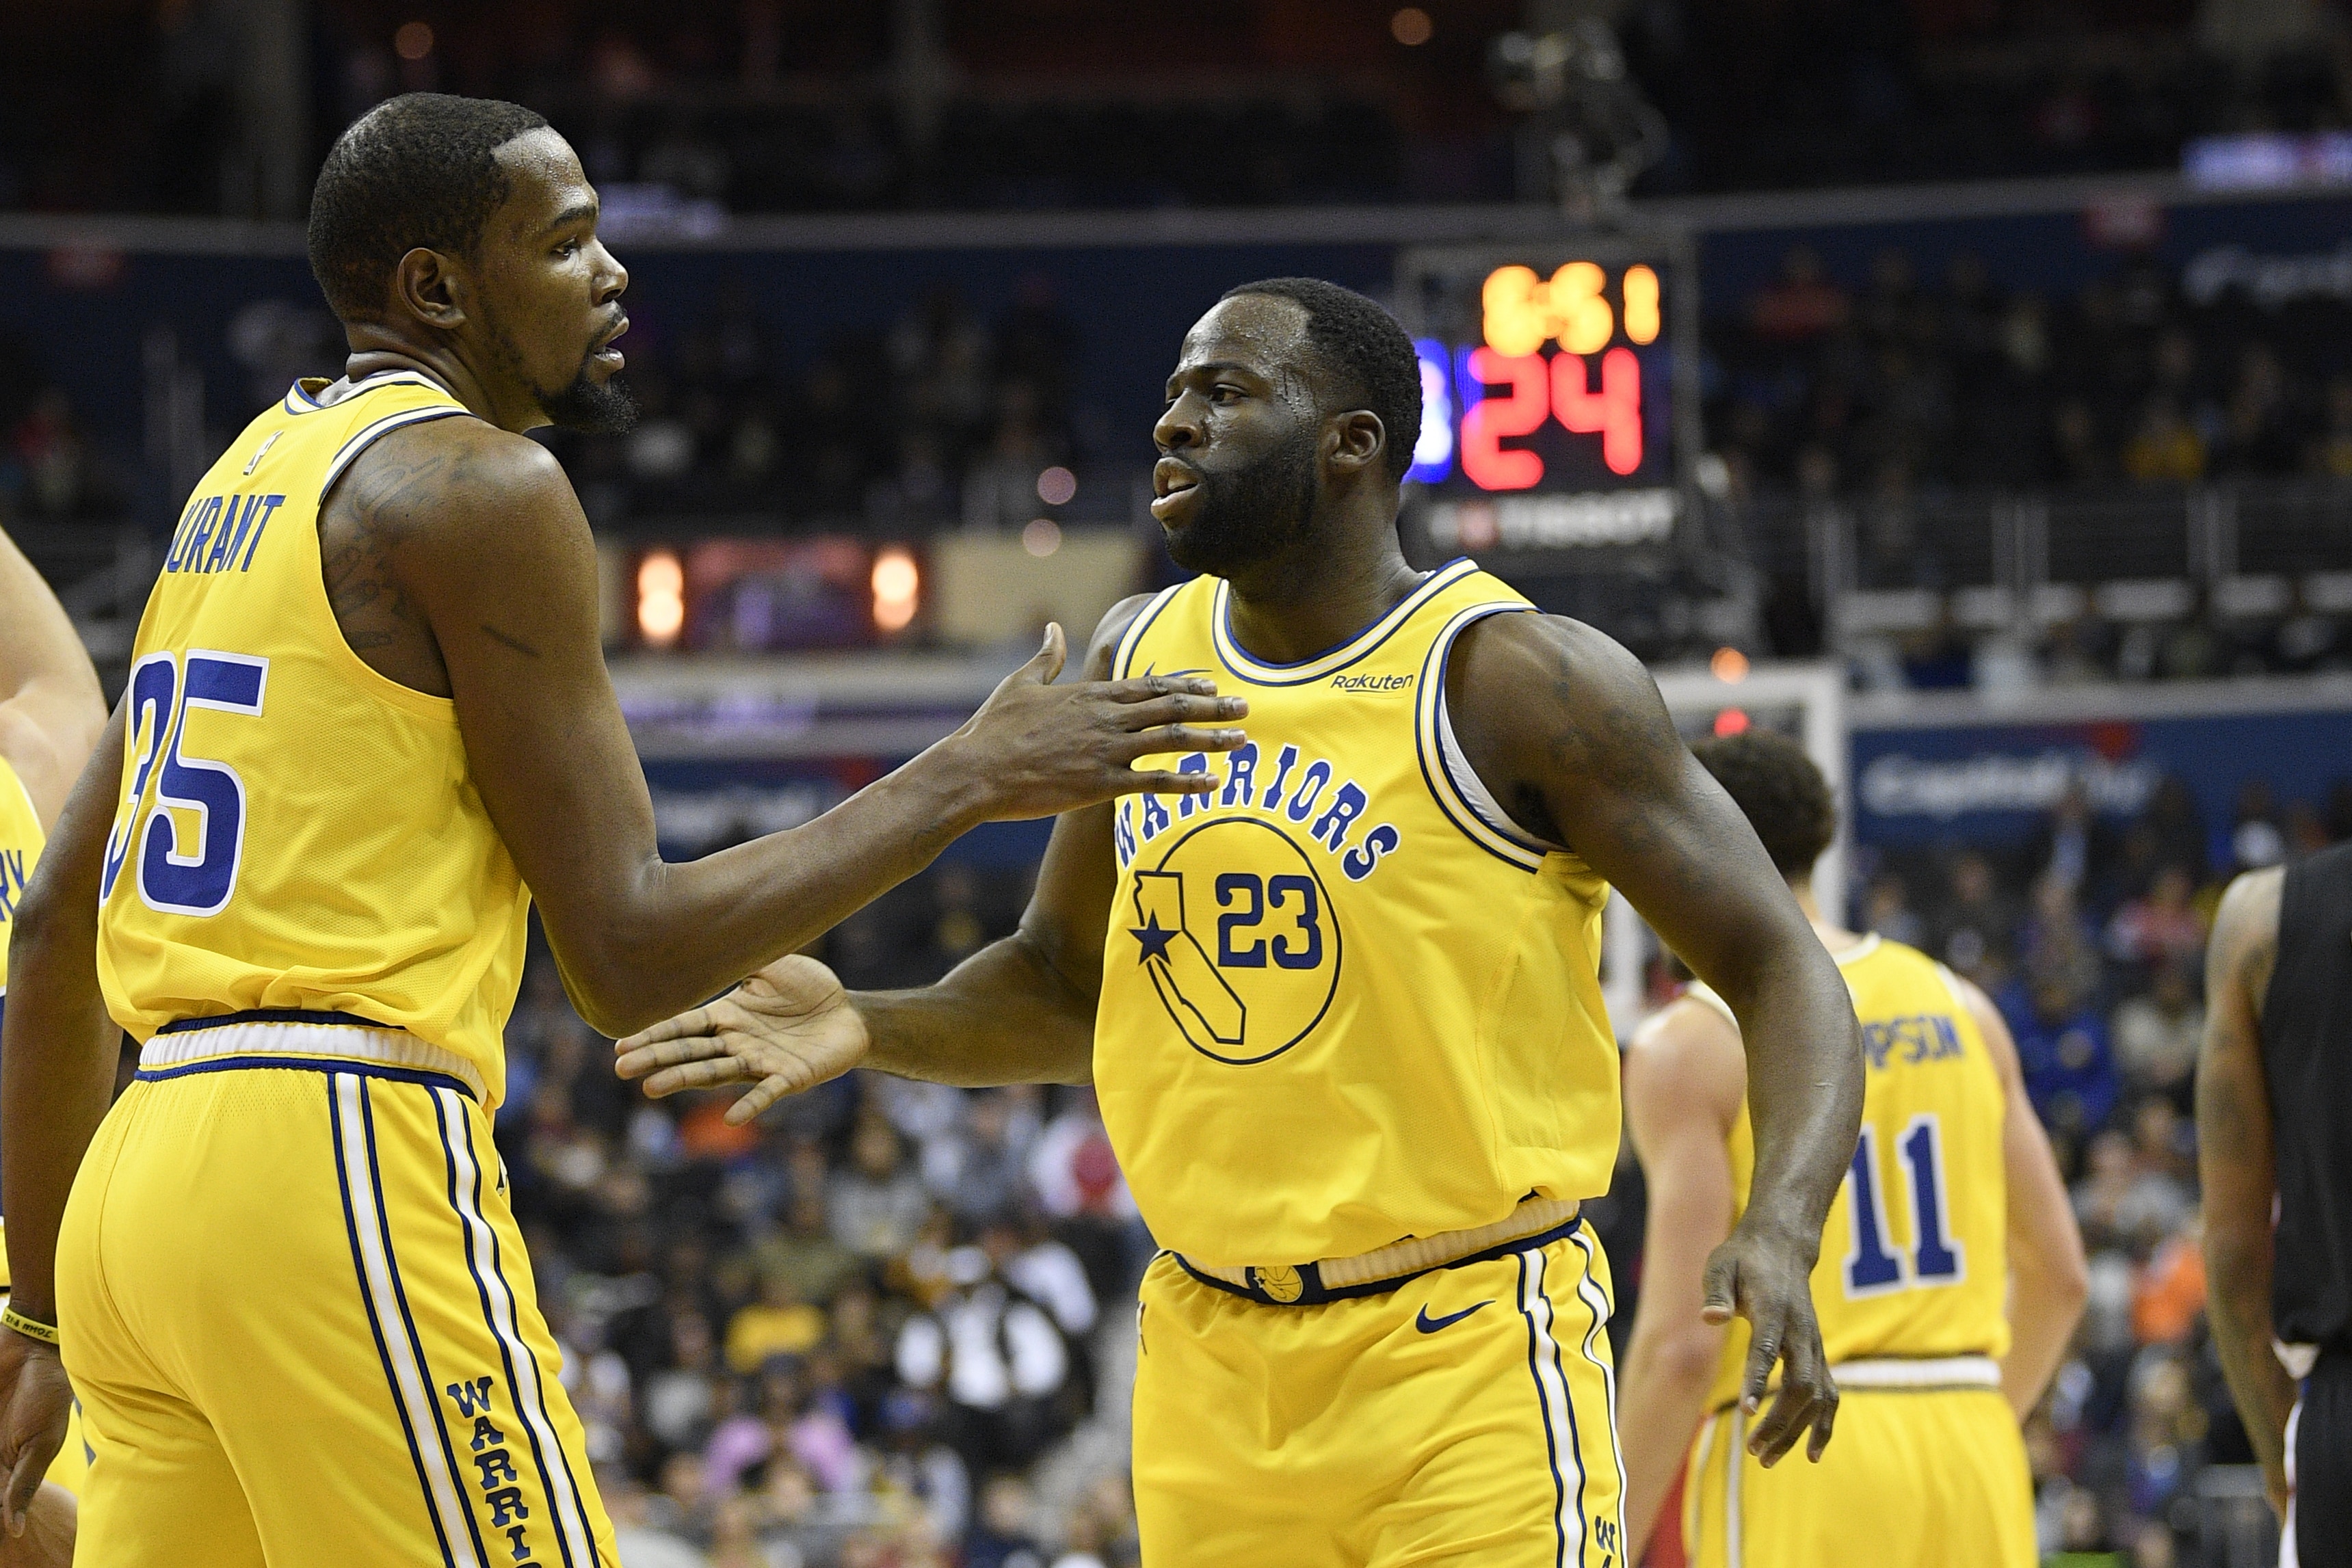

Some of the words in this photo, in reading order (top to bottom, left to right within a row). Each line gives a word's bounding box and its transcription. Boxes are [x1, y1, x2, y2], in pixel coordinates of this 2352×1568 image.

[1461, 347, 1643, 490] 24
[166, 494, 287, 574] URANT
[1330, 674, 1414, 690] Rakuten
[99, 649, 269, 918] 35
[1115, 741, 1401, 883] WARRIORS
[1215, 873, 1323, 969] 23
[1864, 1016, 1962, 1069] PSON
[1843, 1112, 1966, 1302] 11
[447, 1376, 542, 1568] WARRI
